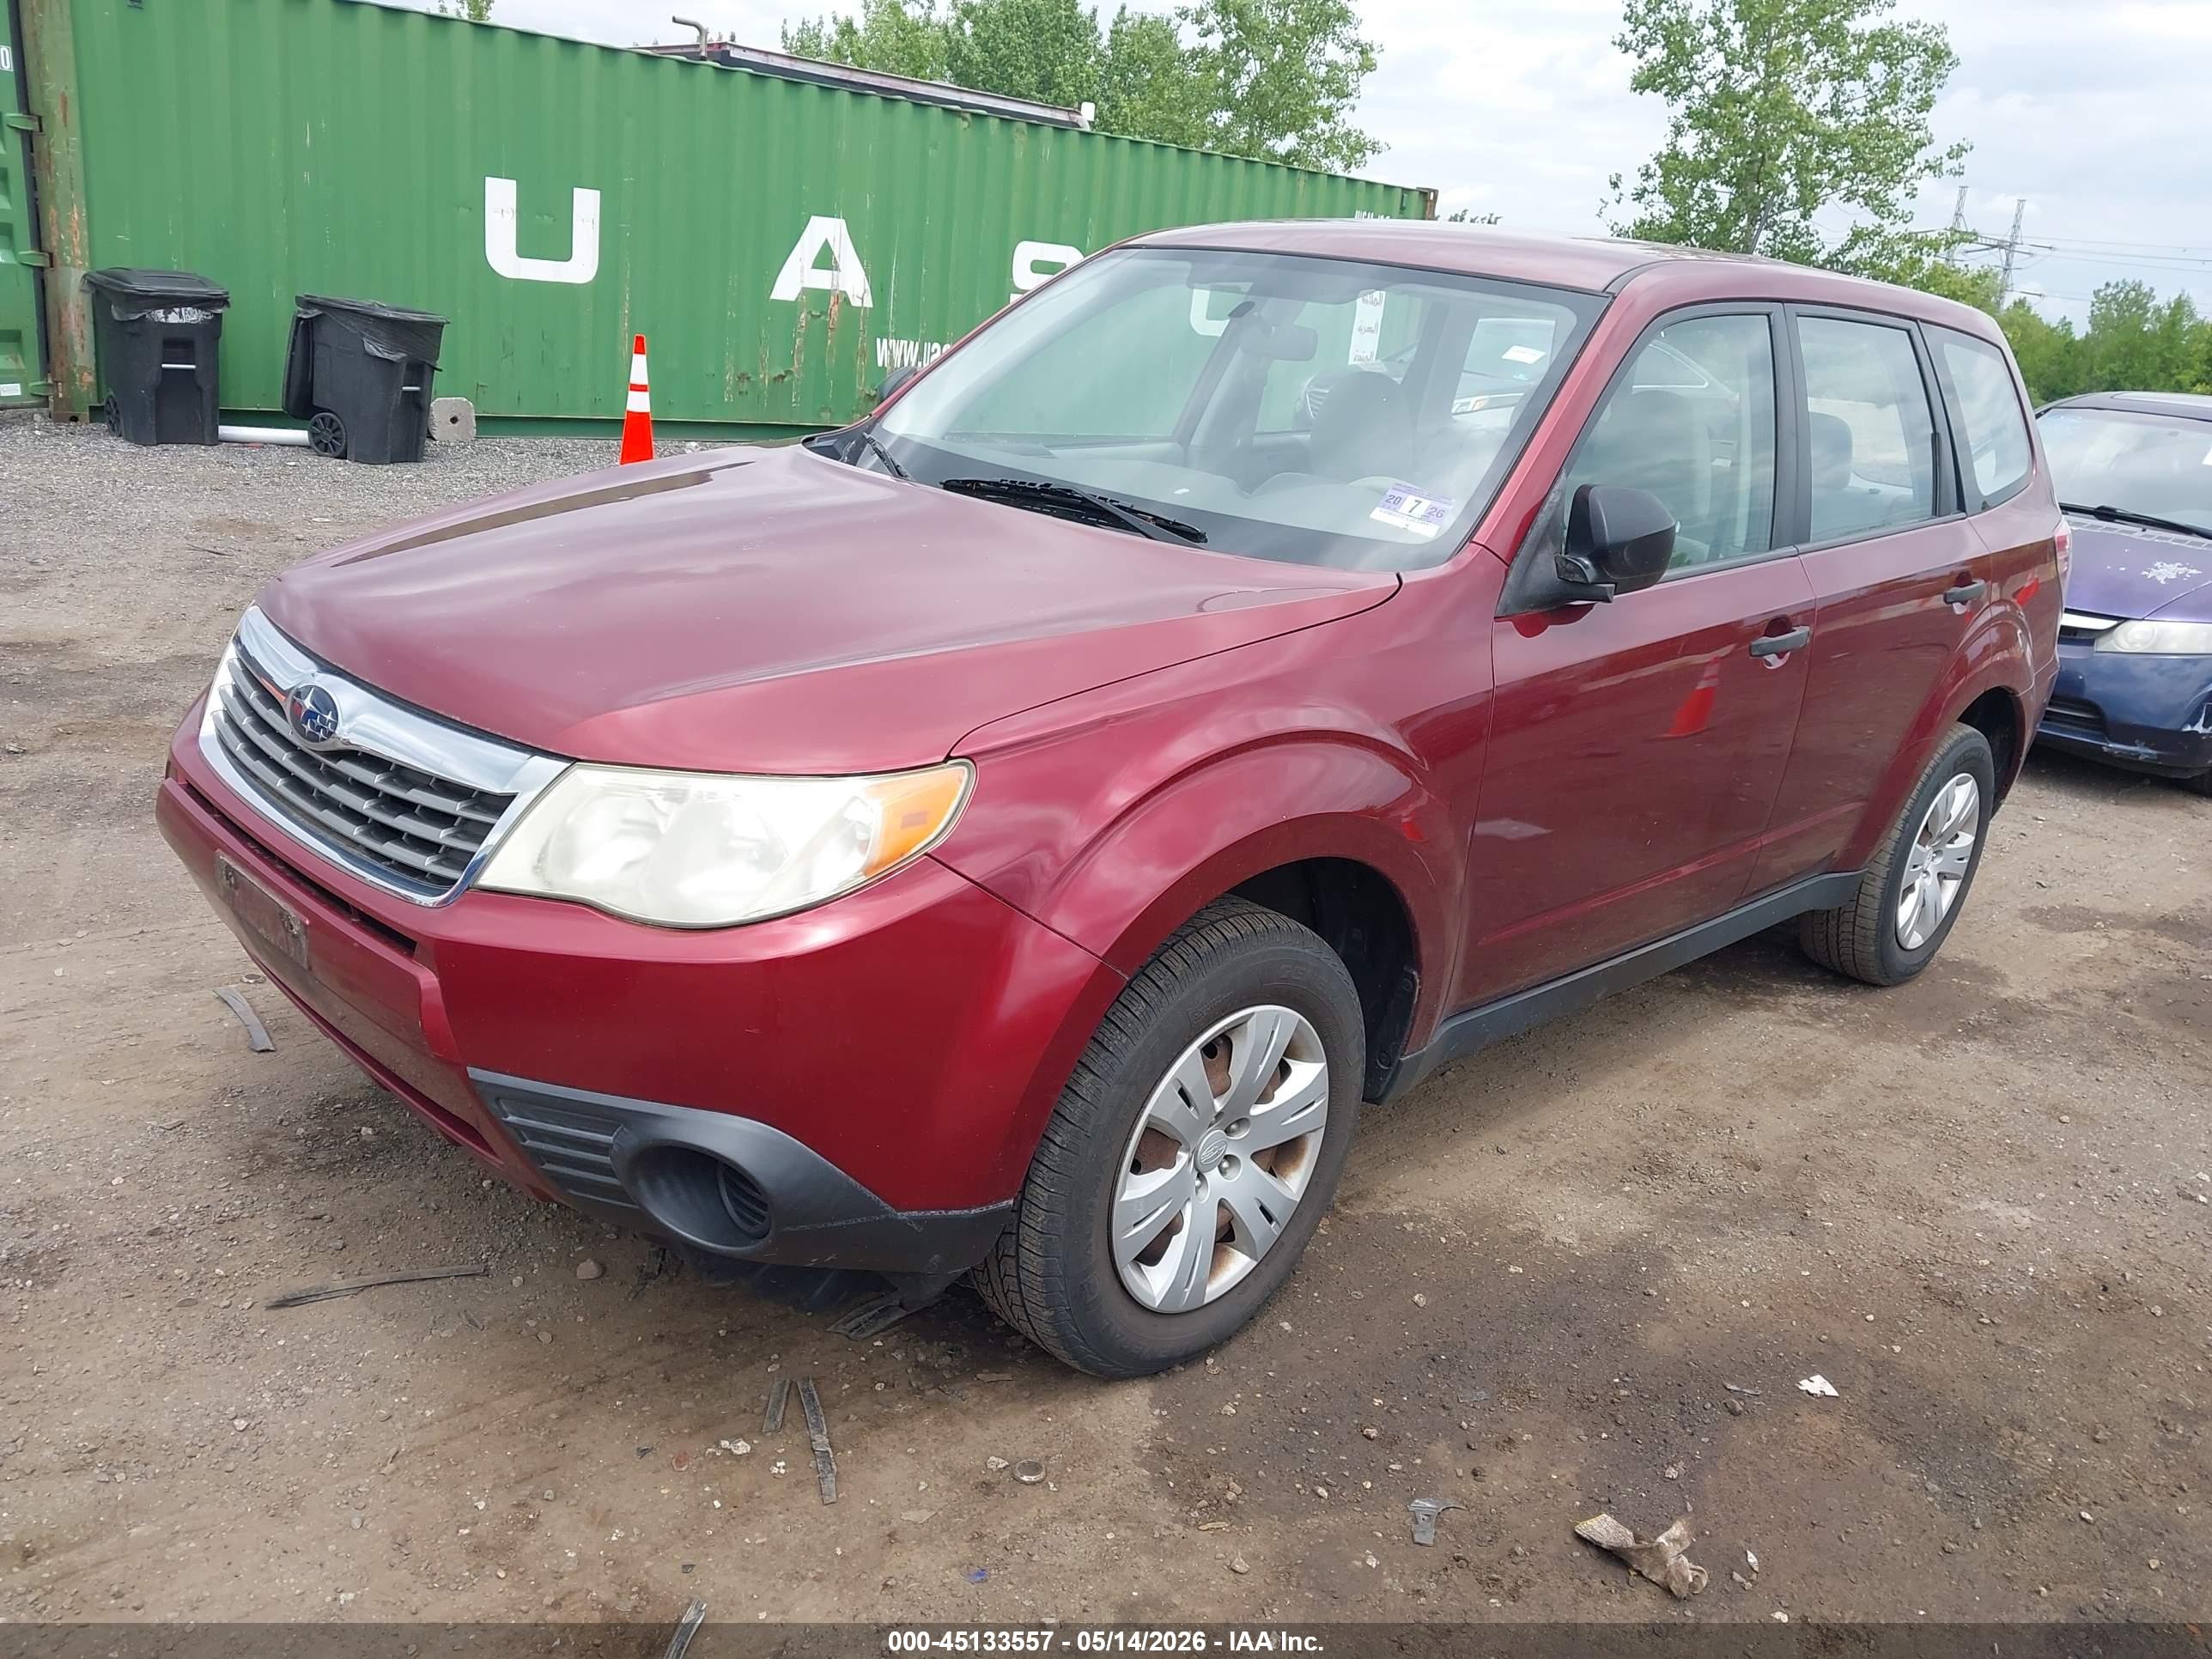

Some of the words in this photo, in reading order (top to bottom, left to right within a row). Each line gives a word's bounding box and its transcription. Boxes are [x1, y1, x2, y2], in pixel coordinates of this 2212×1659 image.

[484, 176, 601, 284] U
[769, 215, 874, 308] A
[1385, 494, 1402, 506] 20
[1408, 499, 1423, 514] 7
[1427, 507, 1446, 519] 26
